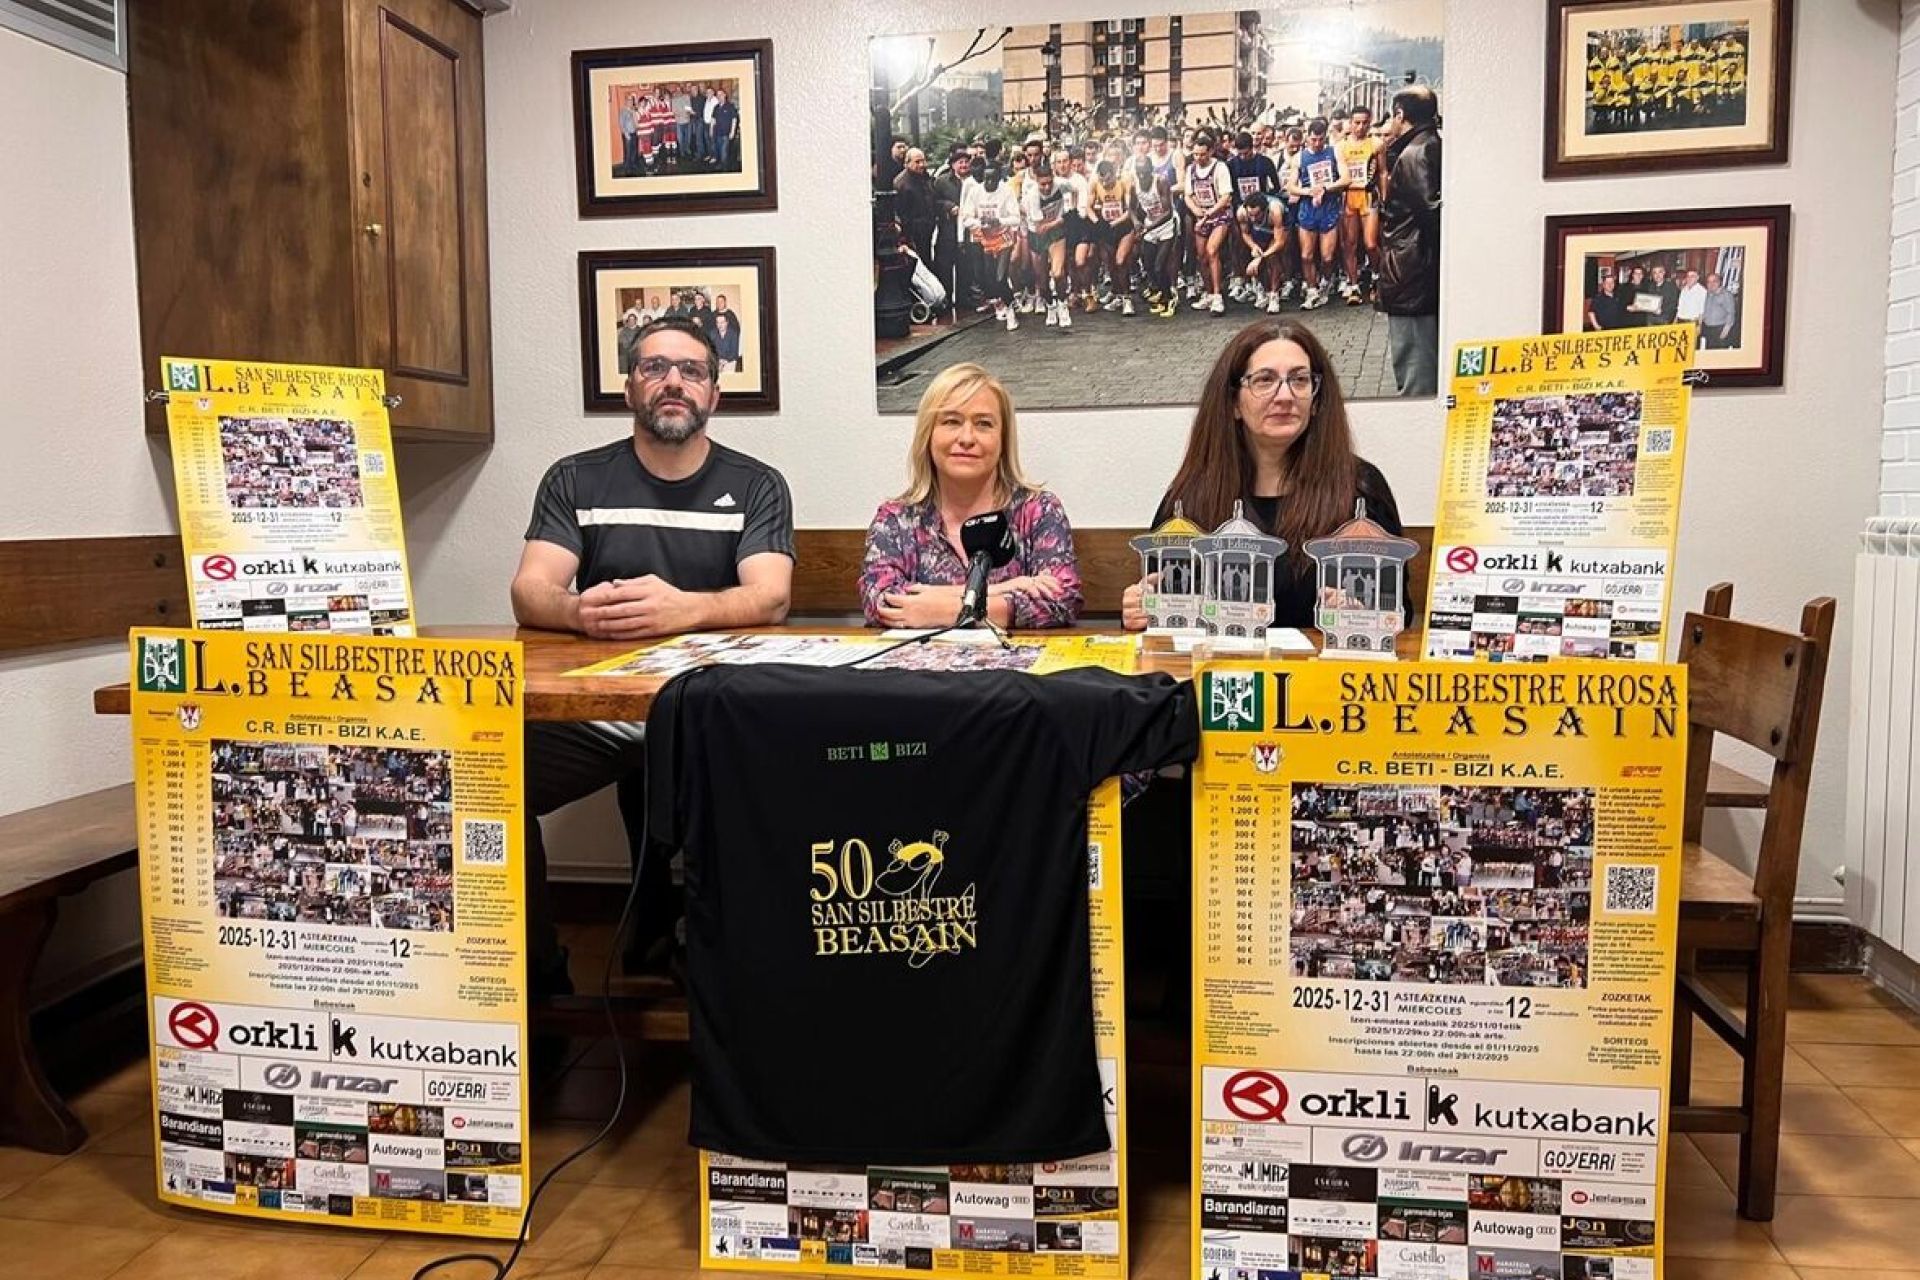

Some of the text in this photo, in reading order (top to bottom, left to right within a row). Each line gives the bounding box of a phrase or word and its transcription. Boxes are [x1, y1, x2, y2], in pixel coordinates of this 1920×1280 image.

[1521, 330, 1689, 358] SAN SILBESTRE KROSA
[1489, 346, 1517, 375] L.
[1520, 346, 1688, 373] BEASAIN
[203, 365, 234, 393] L.
[235, 367, 380, 389] SAN SILBESTRE KROSA
[331, 512, 343, 523] 12
[1485, 501, 1604, 514] 2025-12-31 12
[243, 559, 297, 576] orkli
[324, 560, 403, 575] kutxabank
[1483, 553, 1538, 571] orkli
[1570, 558, 1665, 576] kutxabank
[192, 640, 243, 697] L.
[246, 641, 517, 679] SAN SILBESTRE KROSA
[247, 669, 518, 707] BEASAIN
[1340, 672, 1679, 706] SAN SILBESTRE KROSA
[1273, 672, 1335, 734] L.
[246, 720, 280, 735] C.R.
[285, 722, 323, 737] BETI
[339, 726, 372, 739] BIZI
[376, 729, 427, 742] K.A.E.
[1341, 703, 1678, 738] BEASAIN
[828, 742, 928, 761] BETI BIZI
[1337, 761, 1378, 776] C.R.
[1386, 762, 1434, 777] BETI
[1454, 762, 1494, 777] BIZI
[1502, 764, 1566, 779] K.A.E.
[810, 838, 874, 901] 50
[812, 896, 978, 925] SAN SILBESTRE
[219, 926, 298, 951] 2025-12-31
[390, 938, 411, 958] 12
[815, 920, 978, 956] BEASAIN
[1292, 986, 1390, 1013] 2025-12-31
[1394, 991, 1467, 1005] ASTEAZKENA
[1505, 996, 1531, 1019] 12
[1398, 1004, 1464, 1017] MIERCOLES
[229, 1020, 319, 1052] orkli
[370, 1035, 518, 1068] kutxabank
[161, 1115, 223, 1137] Barandiaran
[1300, 1088, 1410, 1121] orkli
[1475, 1102, 1656, 1138] kutxabank
[372, 1143, 422, 1159] Autowag
[712, 1170, 787, 1190] Barandiaran
[955, 1192, 1010, 1209] Autowag
[1204, 1198, 1287, 1217] Barandiaran
[1473, 1219, 1534, 1240] Autowag
